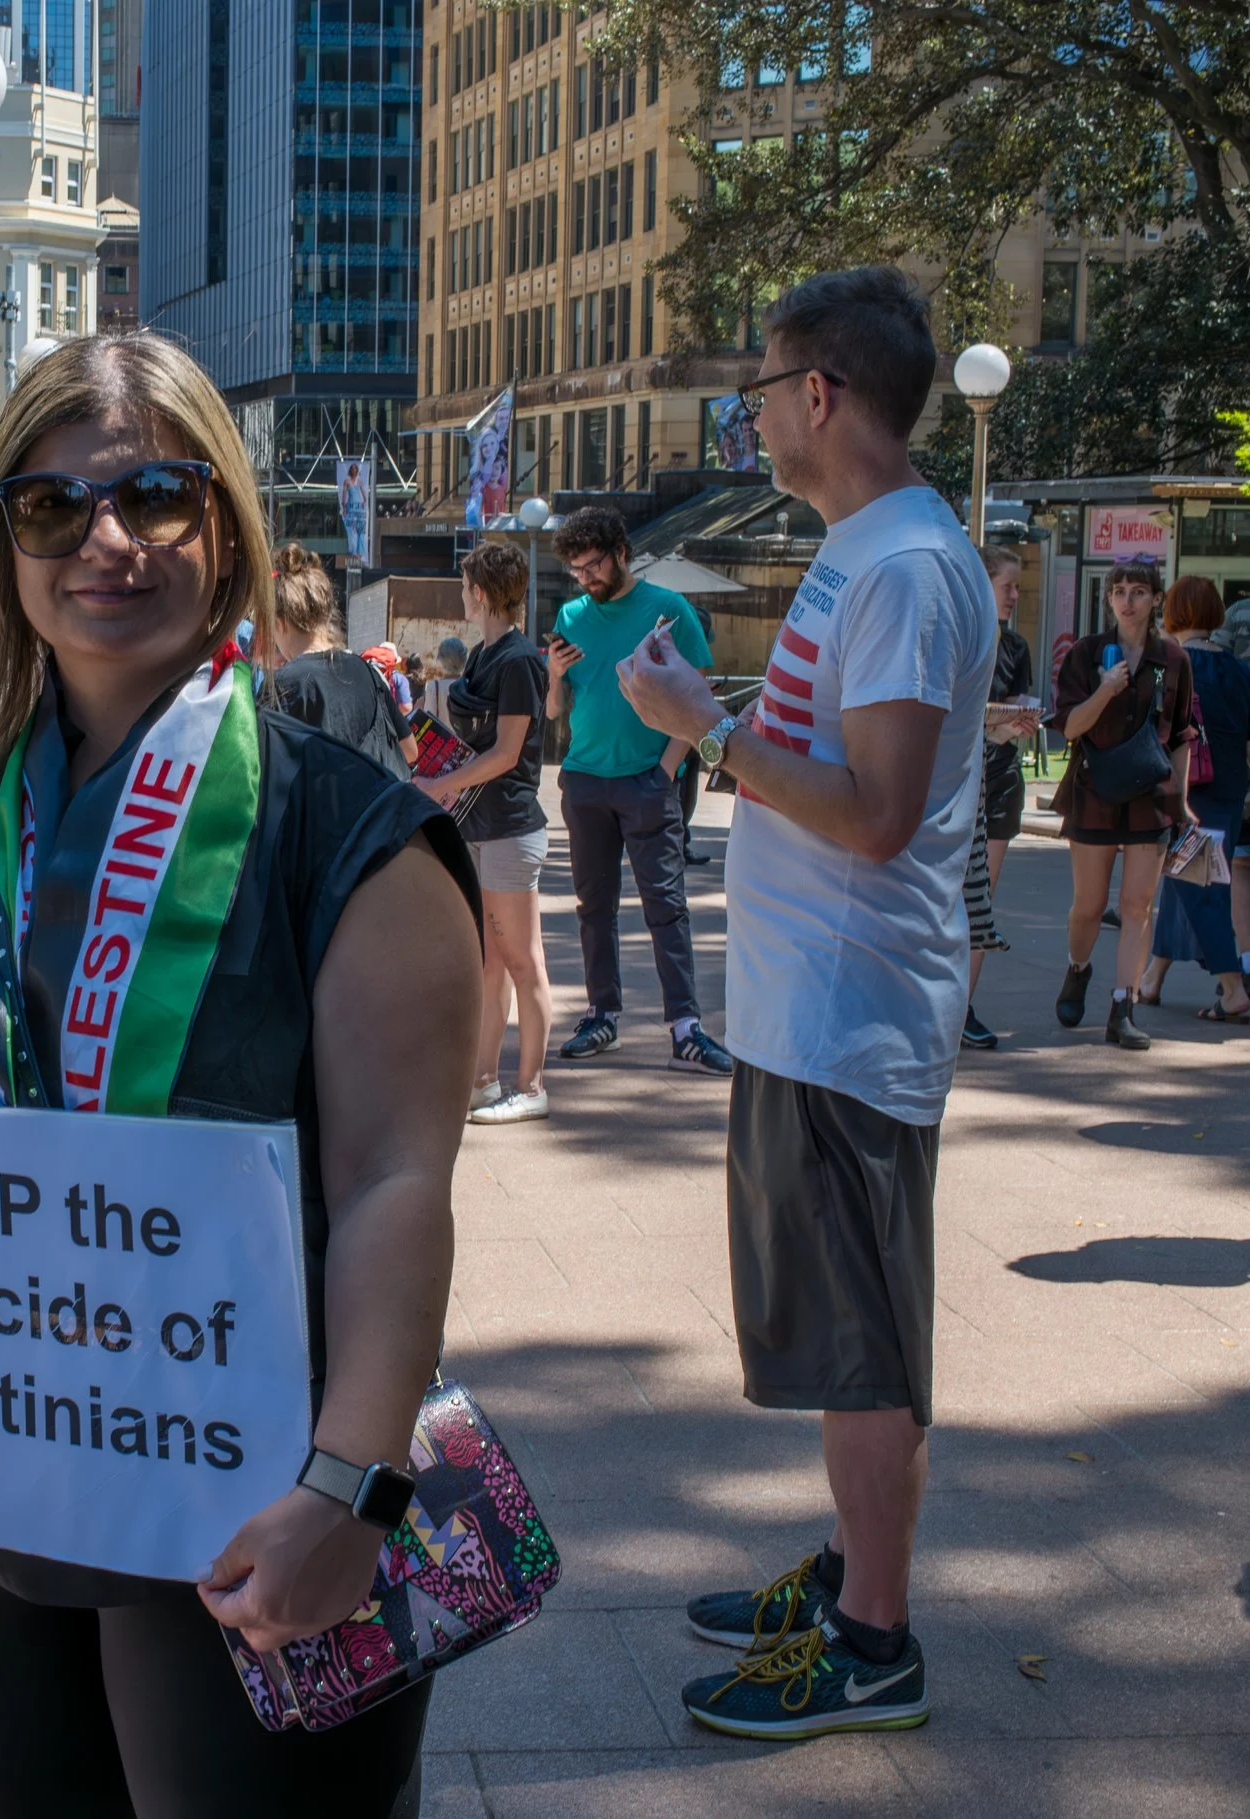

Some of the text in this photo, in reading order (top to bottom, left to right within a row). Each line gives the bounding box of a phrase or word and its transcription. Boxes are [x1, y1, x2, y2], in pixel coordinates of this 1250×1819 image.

[1118, 522, 1163, 542] TAKEAWAY
[812, 561, 848, 593] BIGGEST
[65, 1183, 182, 1256] the
[160, 1301, 236, 1366] of
